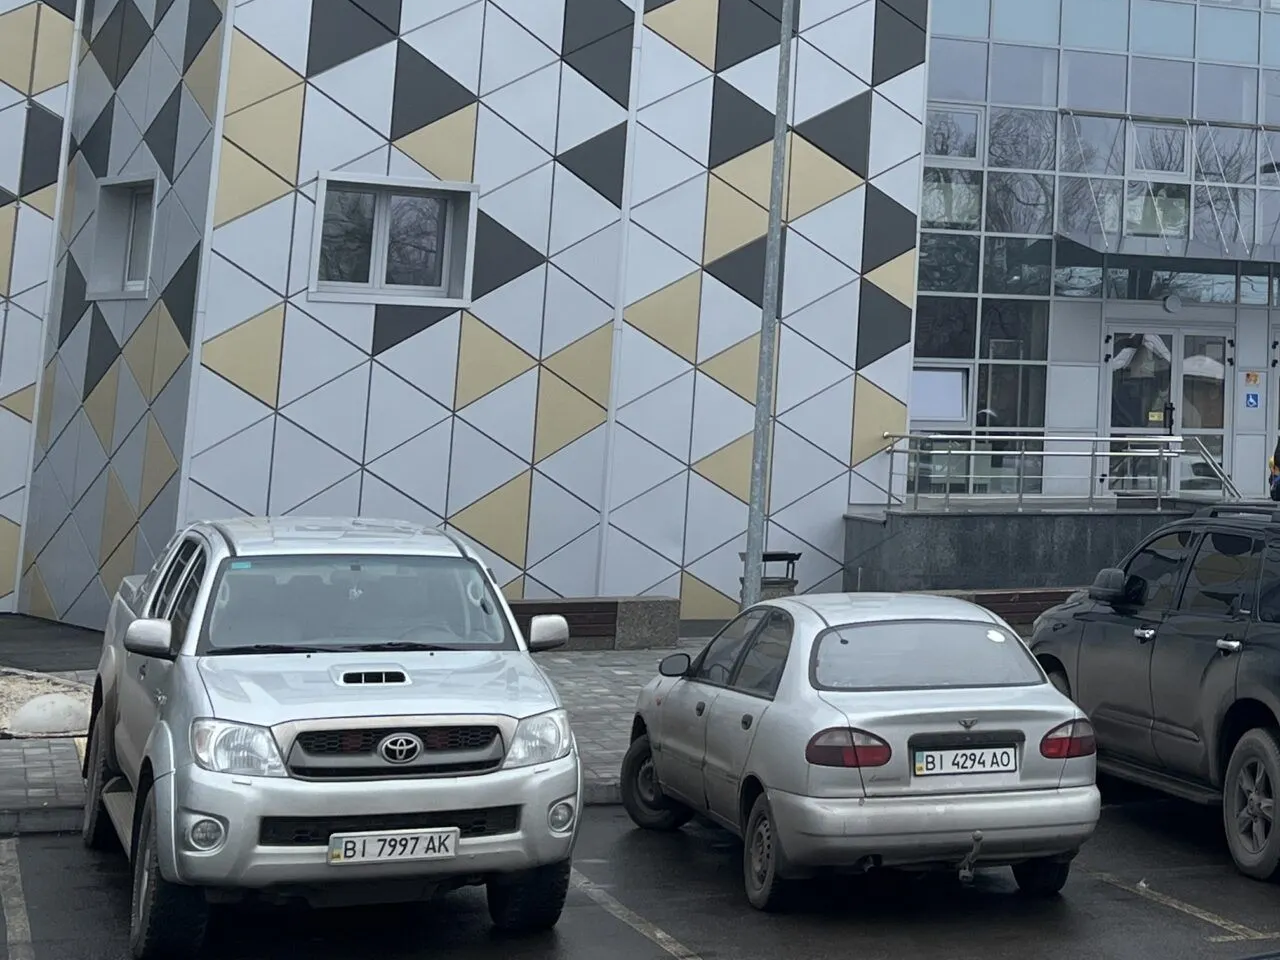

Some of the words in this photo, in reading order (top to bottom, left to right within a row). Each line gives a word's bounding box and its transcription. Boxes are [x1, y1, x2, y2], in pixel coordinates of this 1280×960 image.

[925, 754, 943, 771] BI
[951, 752, 986, 769] 4294
[344, 839, 367, 859] BI
[376, 837, 420, 857] 7997
[424, 834, 451, 854] AK
